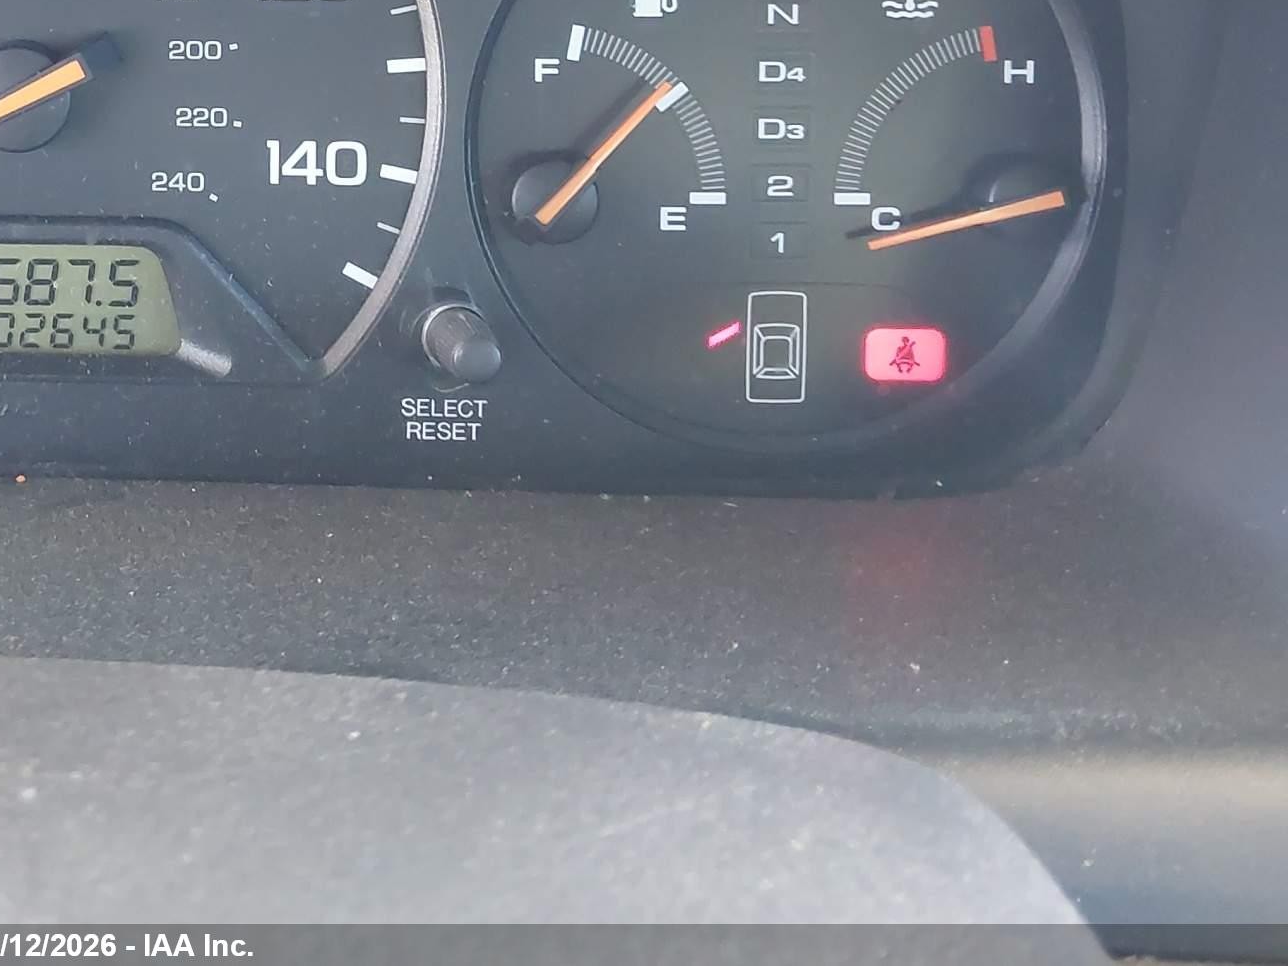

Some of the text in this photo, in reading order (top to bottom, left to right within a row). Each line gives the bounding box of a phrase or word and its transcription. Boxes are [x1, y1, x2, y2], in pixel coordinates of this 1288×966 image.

[766, 4, 800, 26] N
[168, 40, 223, 60] 200
[534, 58, 560, 83] F
[758, 60, 807, 84] D4
[1003, 60, 1036, 84] H
[175, 107, 228, 127] 220
[757, 117, 806, 141] D3
[265, 140, 369, 186] 140
[151, 172, 205, 192] 240
[766, 175, 796, 198] 2
[659, 206, 687, 231] E
[871, 207, 901, 230] C
[768, 233, 785, 254] 1
[400, 398, 488, 419] SELECT
[405, 422, 482, 441] RESET
